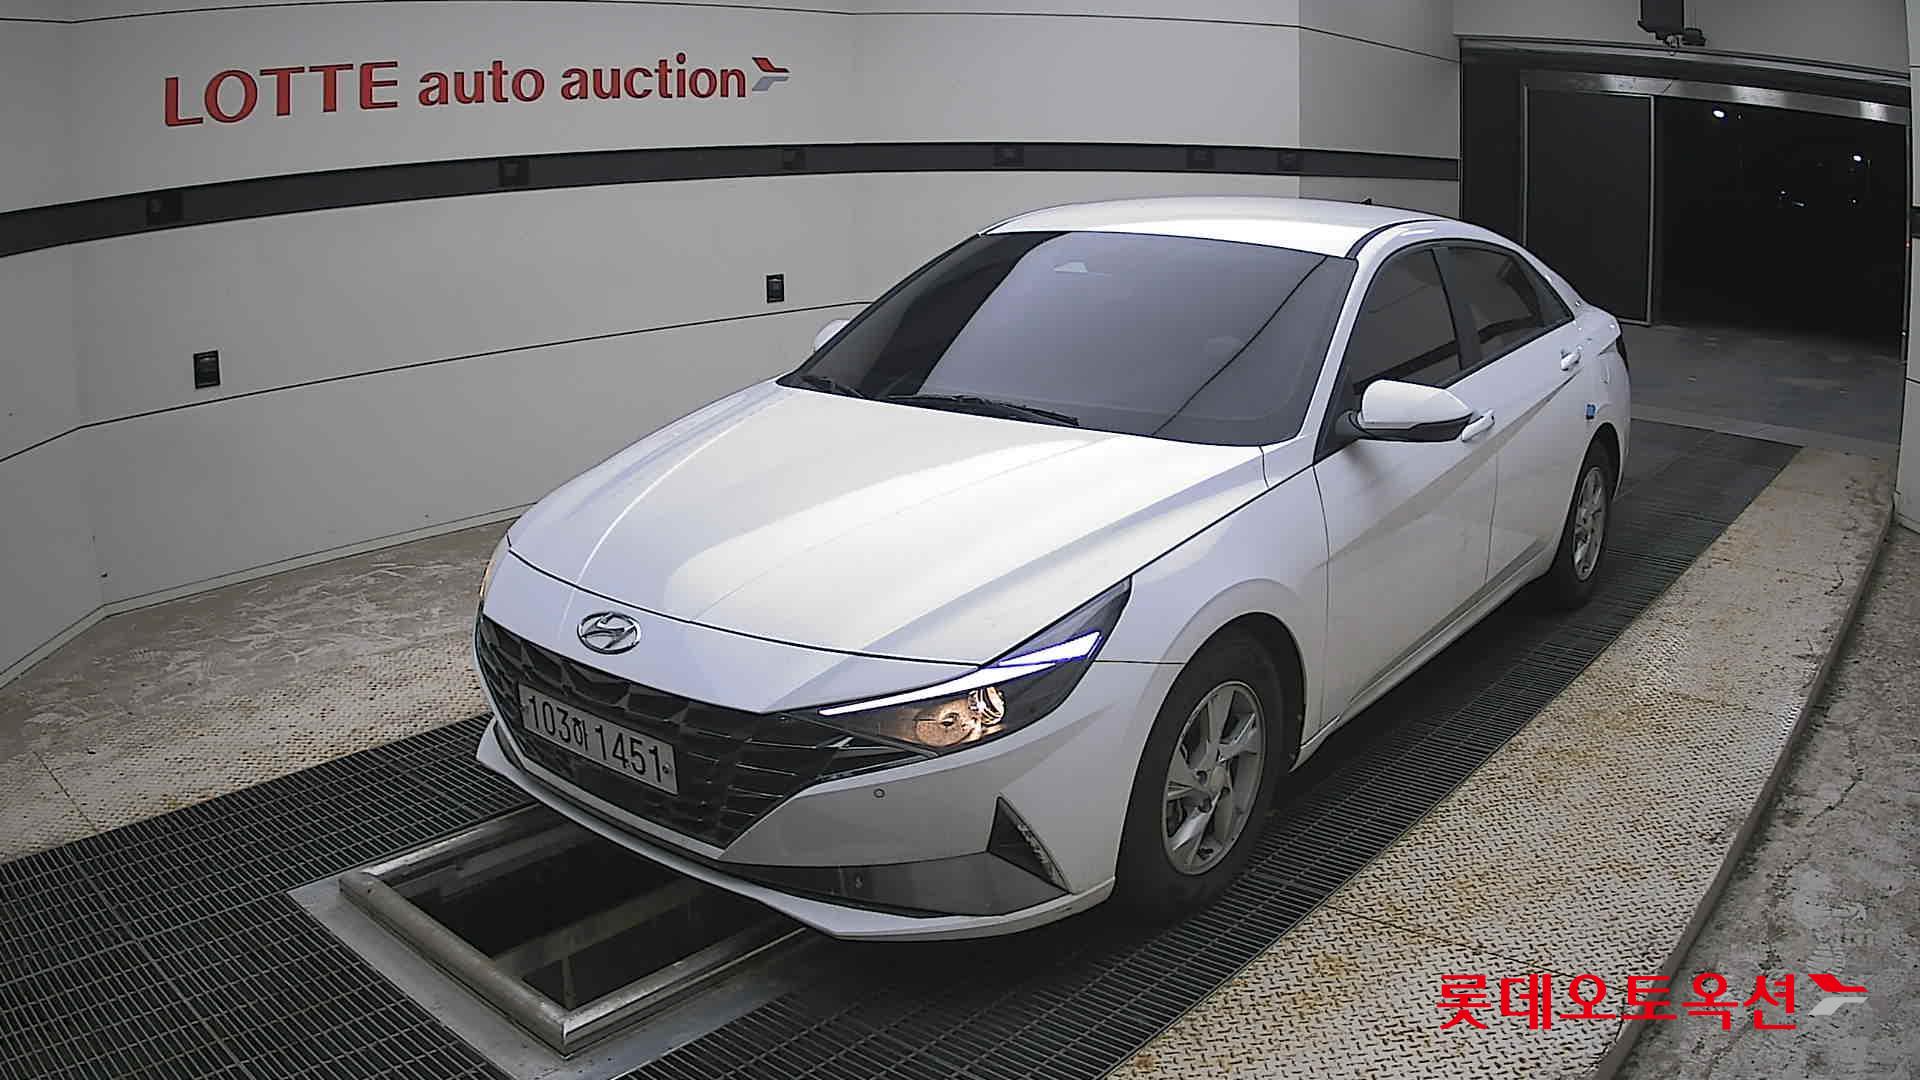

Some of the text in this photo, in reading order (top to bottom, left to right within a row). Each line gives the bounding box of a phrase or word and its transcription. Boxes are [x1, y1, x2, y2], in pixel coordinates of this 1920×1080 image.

[164, 52, 746, 126] LOTTE auto auction
[528, 696, 662, 783] 103하 1451
